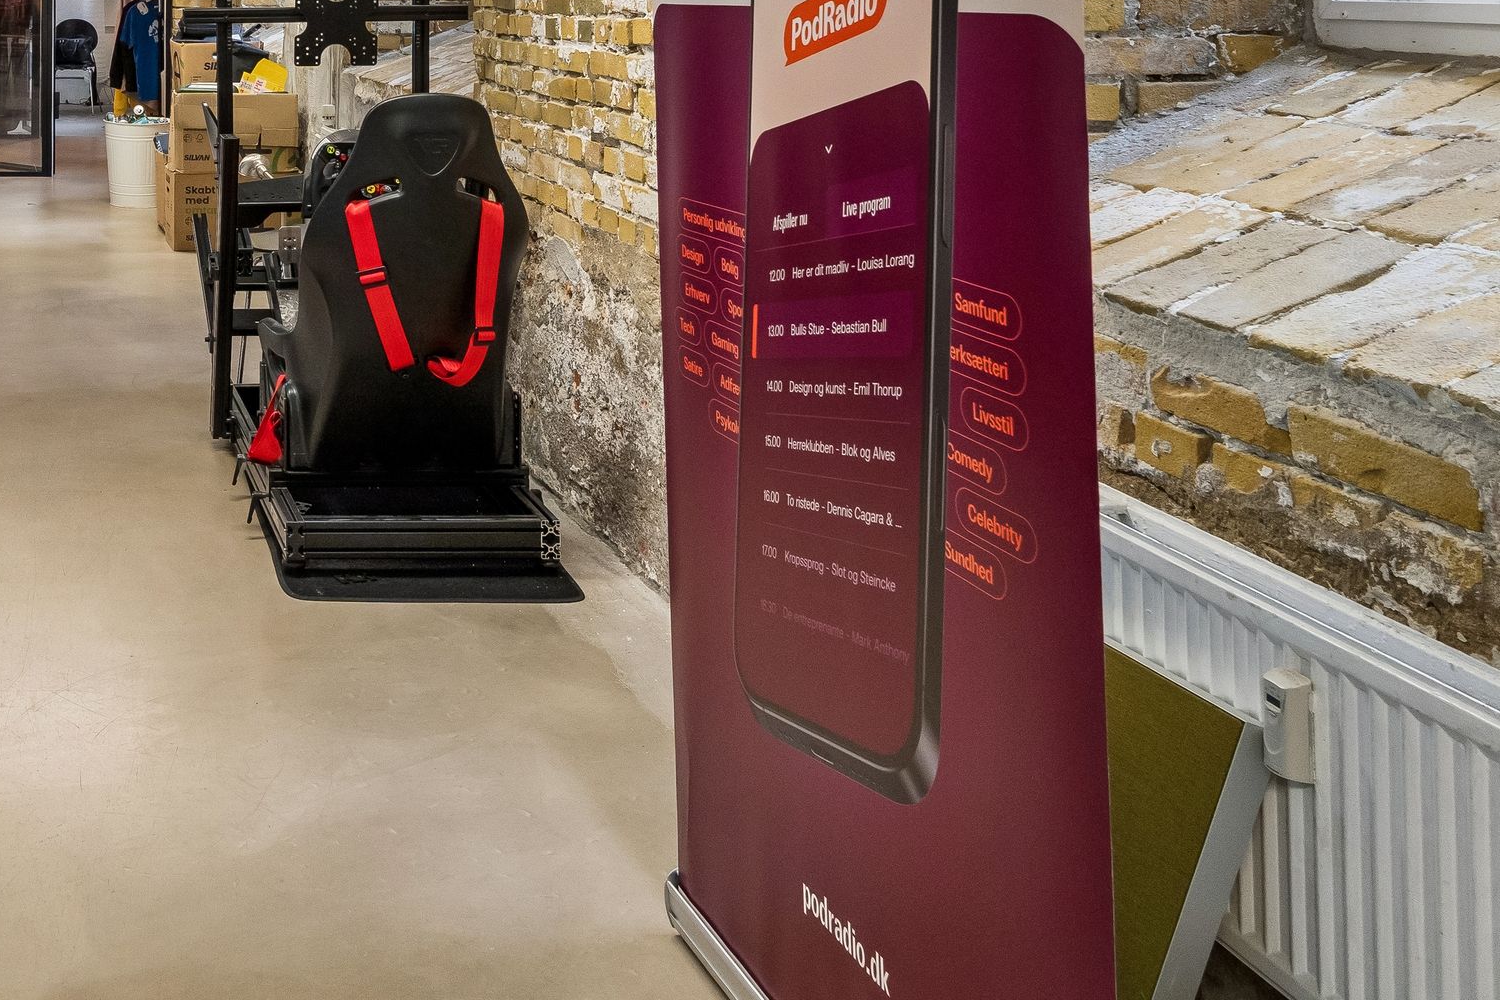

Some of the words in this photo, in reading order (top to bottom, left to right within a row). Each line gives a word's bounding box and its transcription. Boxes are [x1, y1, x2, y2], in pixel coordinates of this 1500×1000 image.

[185, 185, 215, 195] Skabt
[185, 195, 210, 205] med
[683, 207, 714, 233] Personlig
[842, 201, 858, 218] Live
[859, 195, 891, 220] program
[772, 212, 799, 234] Afspiller
[799, 213, 808, 226] nu
[681, 244, 704, 266] Design
[792, 266, 805, 279] Her
[806, 267, 814, 278] er
[814, 263, 824, 276] dit
[825, 260, 849, 275] madliv
[857, 255, 884, 272] Louisa
[885, 253, 915, 269] Lorang
[721, 257, 739, 280] Bolig
[685, 282, 710, 304] Erhverv
[727, 299, 743, 319] Spo
[955, 292, 1007, 327] Samfund
[679, 317, 695, 336] Tech
[790, 323, 807, 336] Bulls
[808, 322, 824, 335] Stue
[831, 320, 870, 334] Sebastian
[871, 318, 887, 333] Bull
[711, 332, 739, 360] Gaming
[683, 356, 703, 377] Satire
[789, 380, 813, 397] Design
[814, 383, 824, 397] og
[825, 382, 846, 395] kunst
[853, 382, 871, 396] Emil
[872, 382, 903, 400] Thorup
[972, 401, 1014, 436] Livsstil
[787, 437, 834, 454] Herreklubben
[841, 443, 858, 458] Blok
[860, 447, 871, 463] og
[872, 446, 896, 462] Alves
[948, 442, 993, 484] Comedy
[786, 493, 794, 507] To
[796, 495, 820, 512] ristede
[826, 501, 853, 519] Dennis
[854, 506, 884, 526] Cagara
[885, 512, 894, 527] &
[967, 504, 1023, 552] Celebrity
[784, 550, 824, 575] Kropssprog
[831, 562, 847, 579] Slot
[848, 570, 859, 586] og
[860, 570, 896, 593] Steincke
[944, 540, 993, 585] Sundhed
[802, 882, 891, 998] podradio.dk
